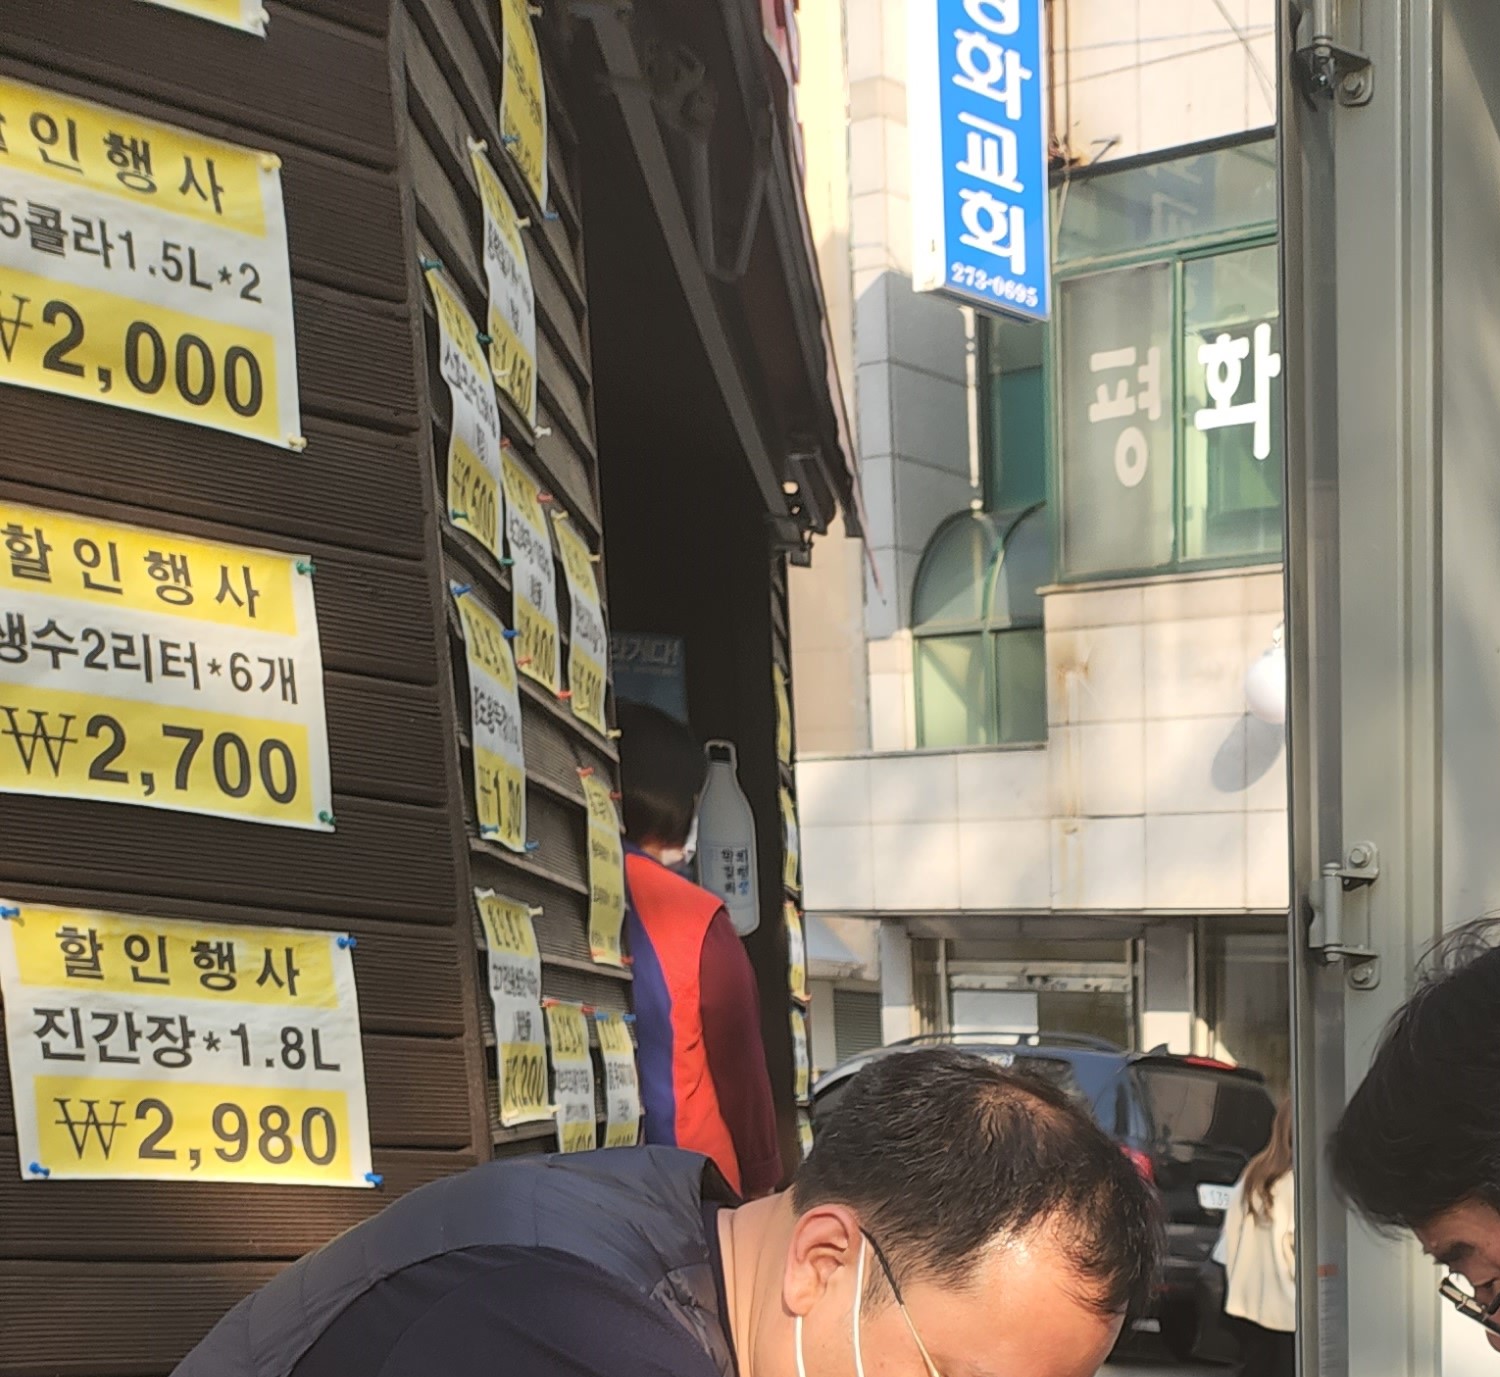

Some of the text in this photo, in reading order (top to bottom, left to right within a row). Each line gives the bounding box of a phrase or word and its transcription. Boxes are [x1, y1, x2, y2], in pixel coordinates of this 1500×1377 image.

[0, 111, 224, 216] 인행사
[1, 523, 261, 618] 할인행사
[55, 926, 301, 997] 할인행사
[52, 1097, 339, 1173] ₩2,980
